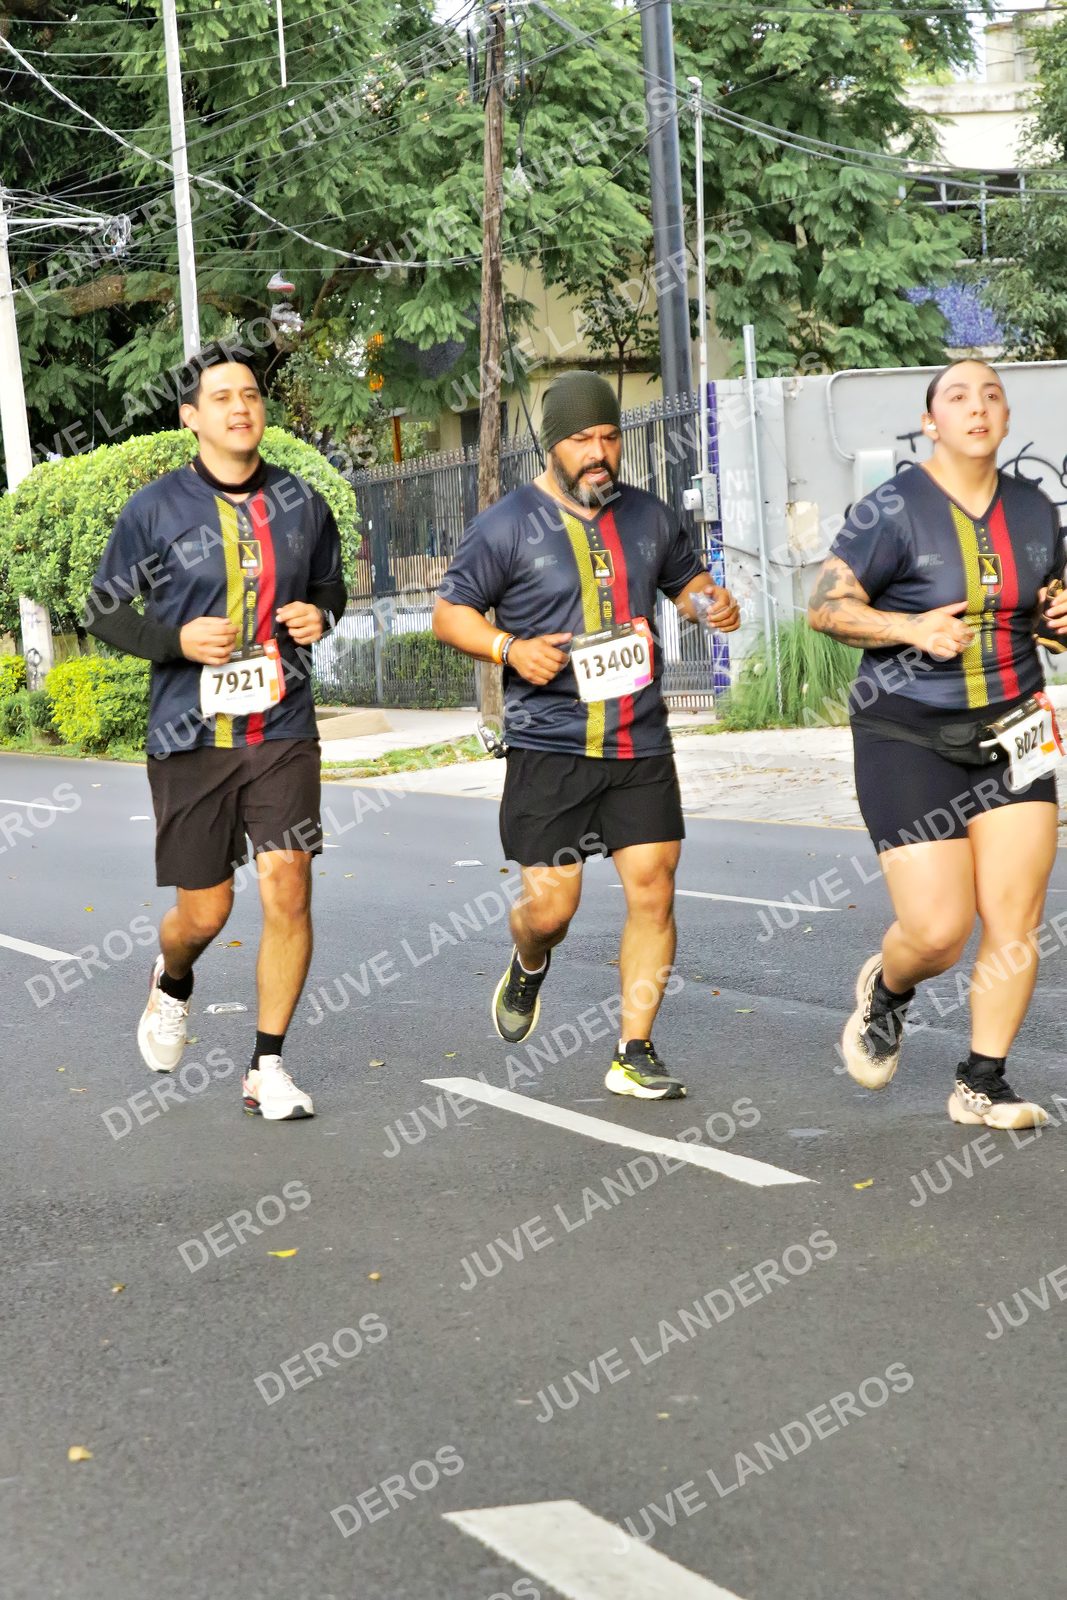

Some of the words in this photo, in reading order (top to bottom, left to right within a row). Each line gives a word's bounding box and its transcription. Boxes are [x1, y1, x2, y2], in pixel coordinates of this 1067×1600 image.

[579, 642, 645, 679] 13400
[212, 665, 264, 695] 7921
[1014, 720, 1044, 760] 8021
